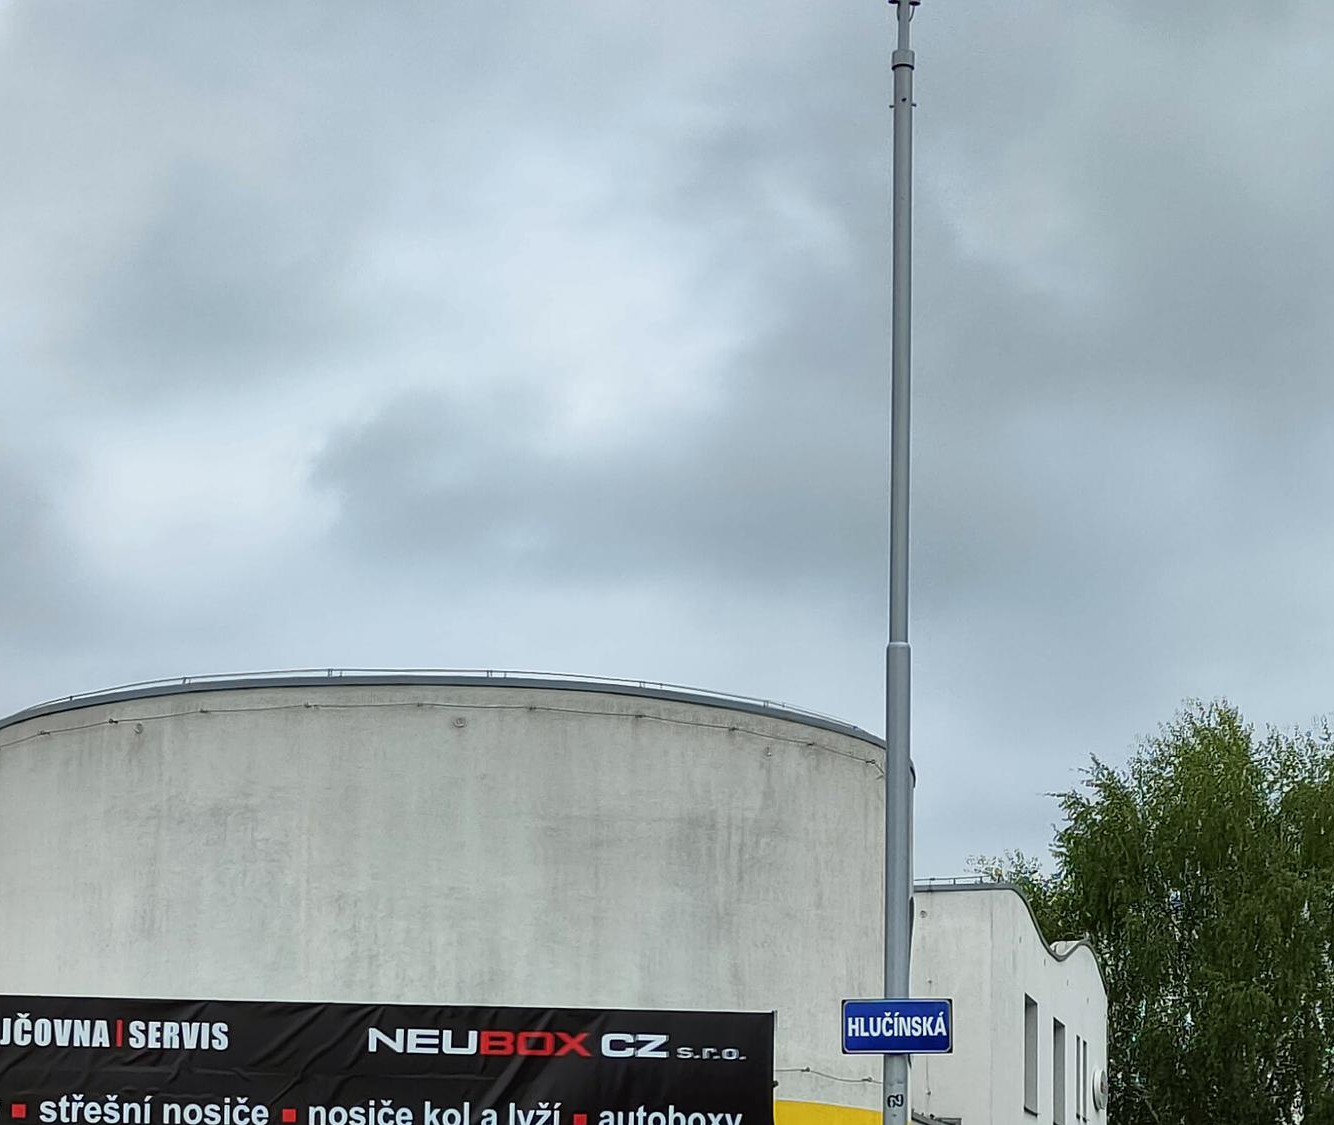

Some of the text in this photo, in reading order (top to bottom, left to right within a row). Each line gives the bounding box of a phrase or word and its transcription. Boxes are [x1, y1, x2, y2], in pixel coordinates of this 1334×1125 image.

[128, 1020, 229, 1051] SERVIS
[847, 1012, 947, 1037] HLUČÍNSKÁ
[368, 1027, 747, 1061] NEUBOX CZ s.r.o.
[39, 1093, 153, 1125] střešní
